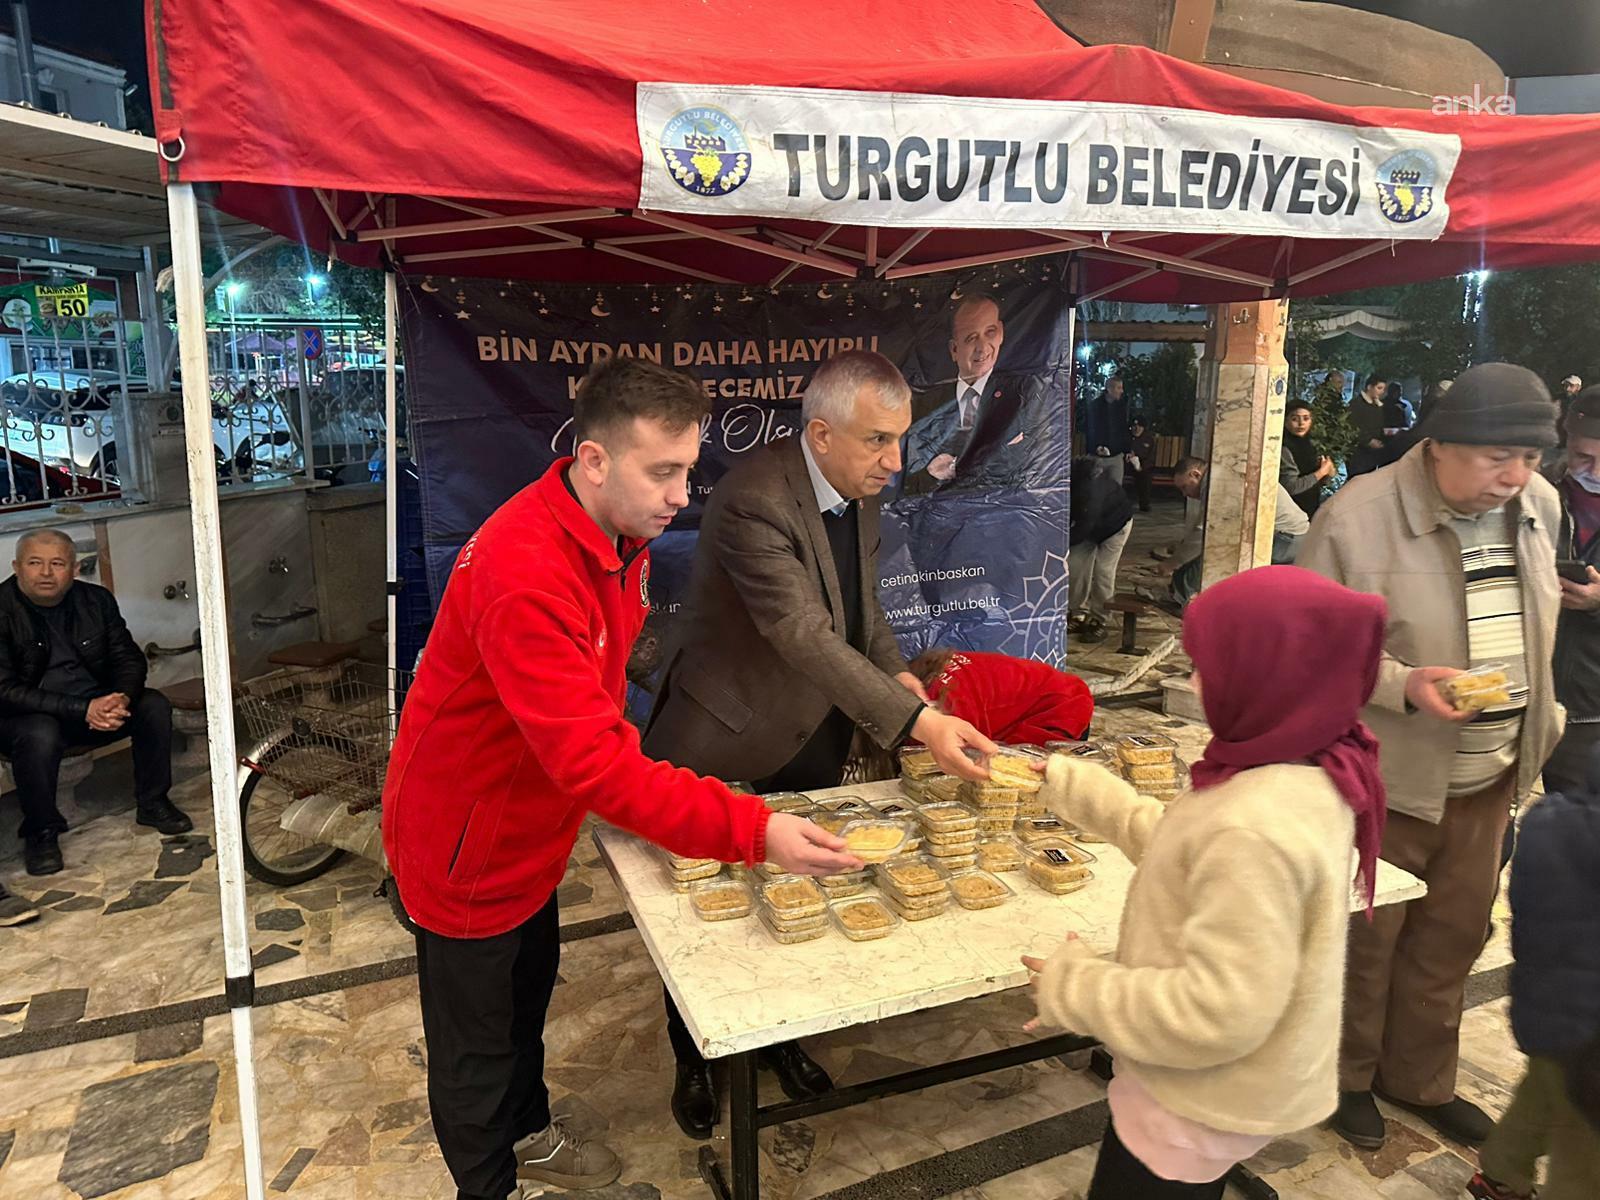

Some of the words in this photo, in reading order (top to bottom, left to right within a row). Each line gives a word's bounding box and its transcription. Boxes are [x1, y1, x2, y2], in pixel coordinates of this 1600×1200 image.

[773, 133, 1068, 204] TURGUTLU
[1086, 138, 1361, 217] BELEDİYESİ
[61, 299, 86, 317] 50
[477, 330, 538, 362] BİN
[549, 340, 662, 365] AYDAN
[673, 340, 762, 366] DAHA
[703, 370, 804, 400] ECEMİZ
[881, 566, 985, 588] cetinakinbaskan
[883, 596, 1001, 620] www.turgutlu.bel.tr
